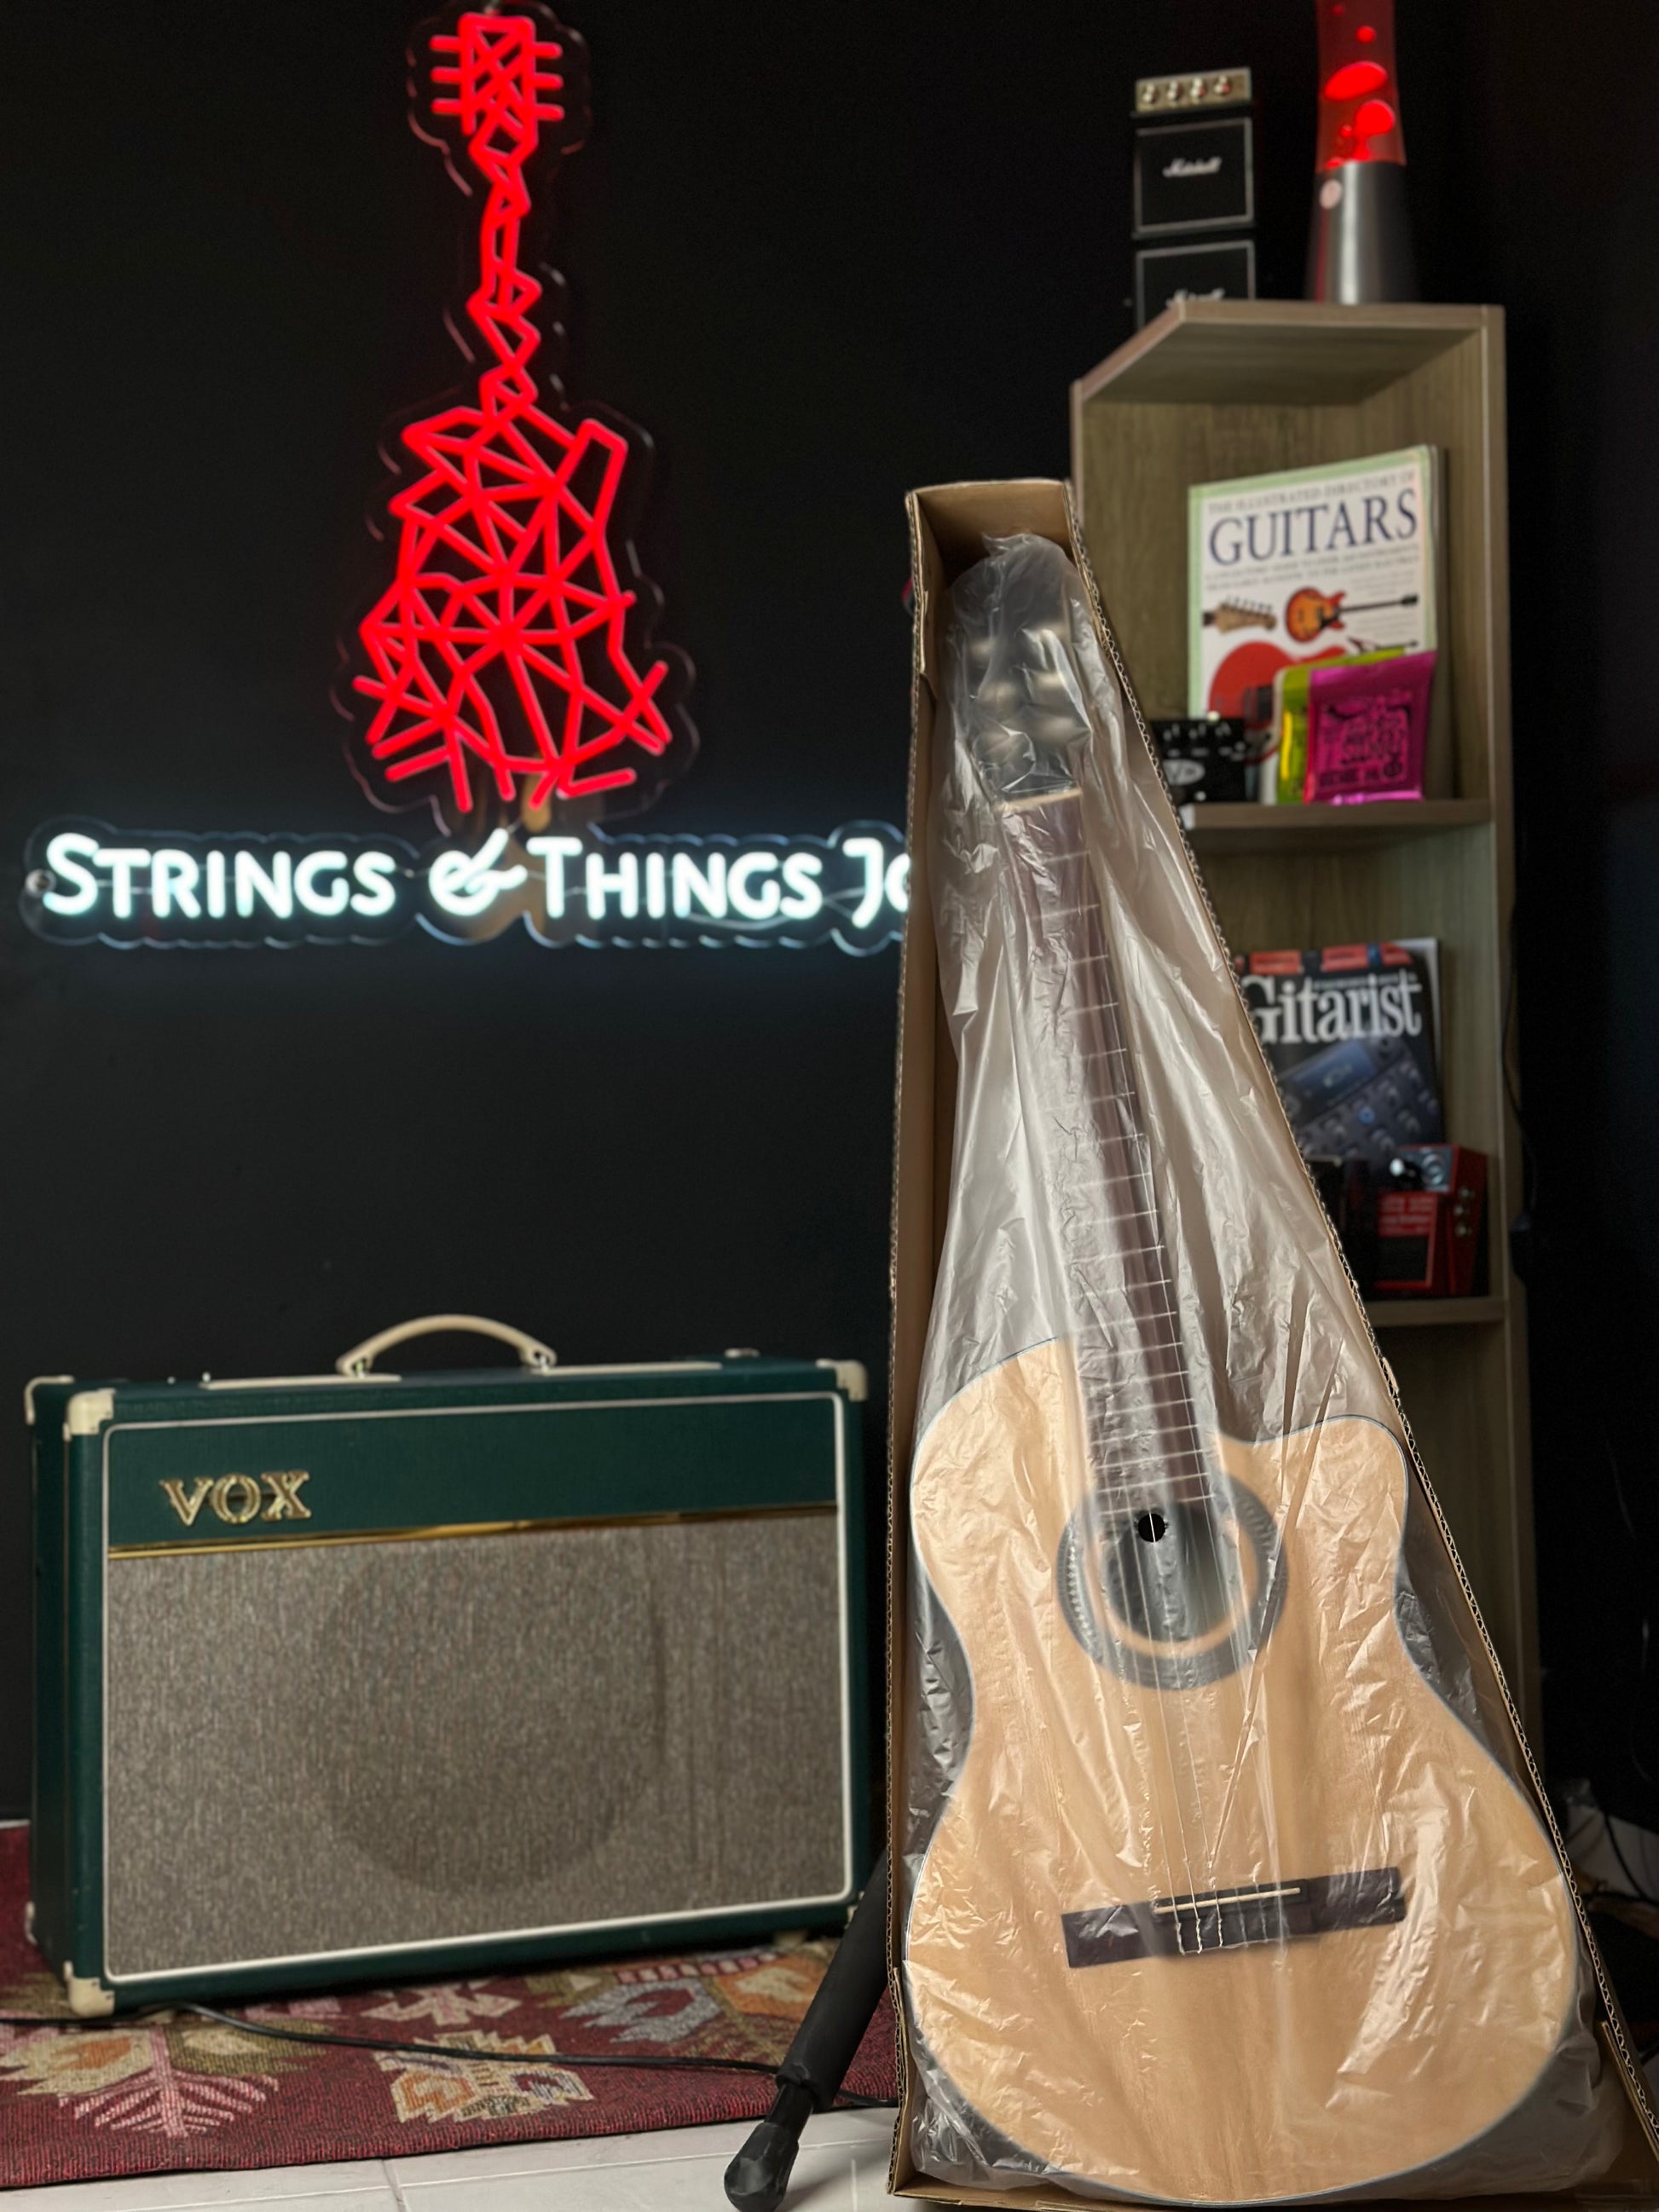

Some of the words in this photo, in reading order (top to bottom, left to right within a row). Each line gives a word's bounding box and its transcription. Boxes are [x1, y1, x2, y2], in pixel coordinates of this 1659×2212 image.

[1209, 488, 1418, 567] GUITARS
[428, 827, 529, 917] &
[1240, 968, 1423, 1045] Gitarist
[159, 1470, 312, 1527] VOX
